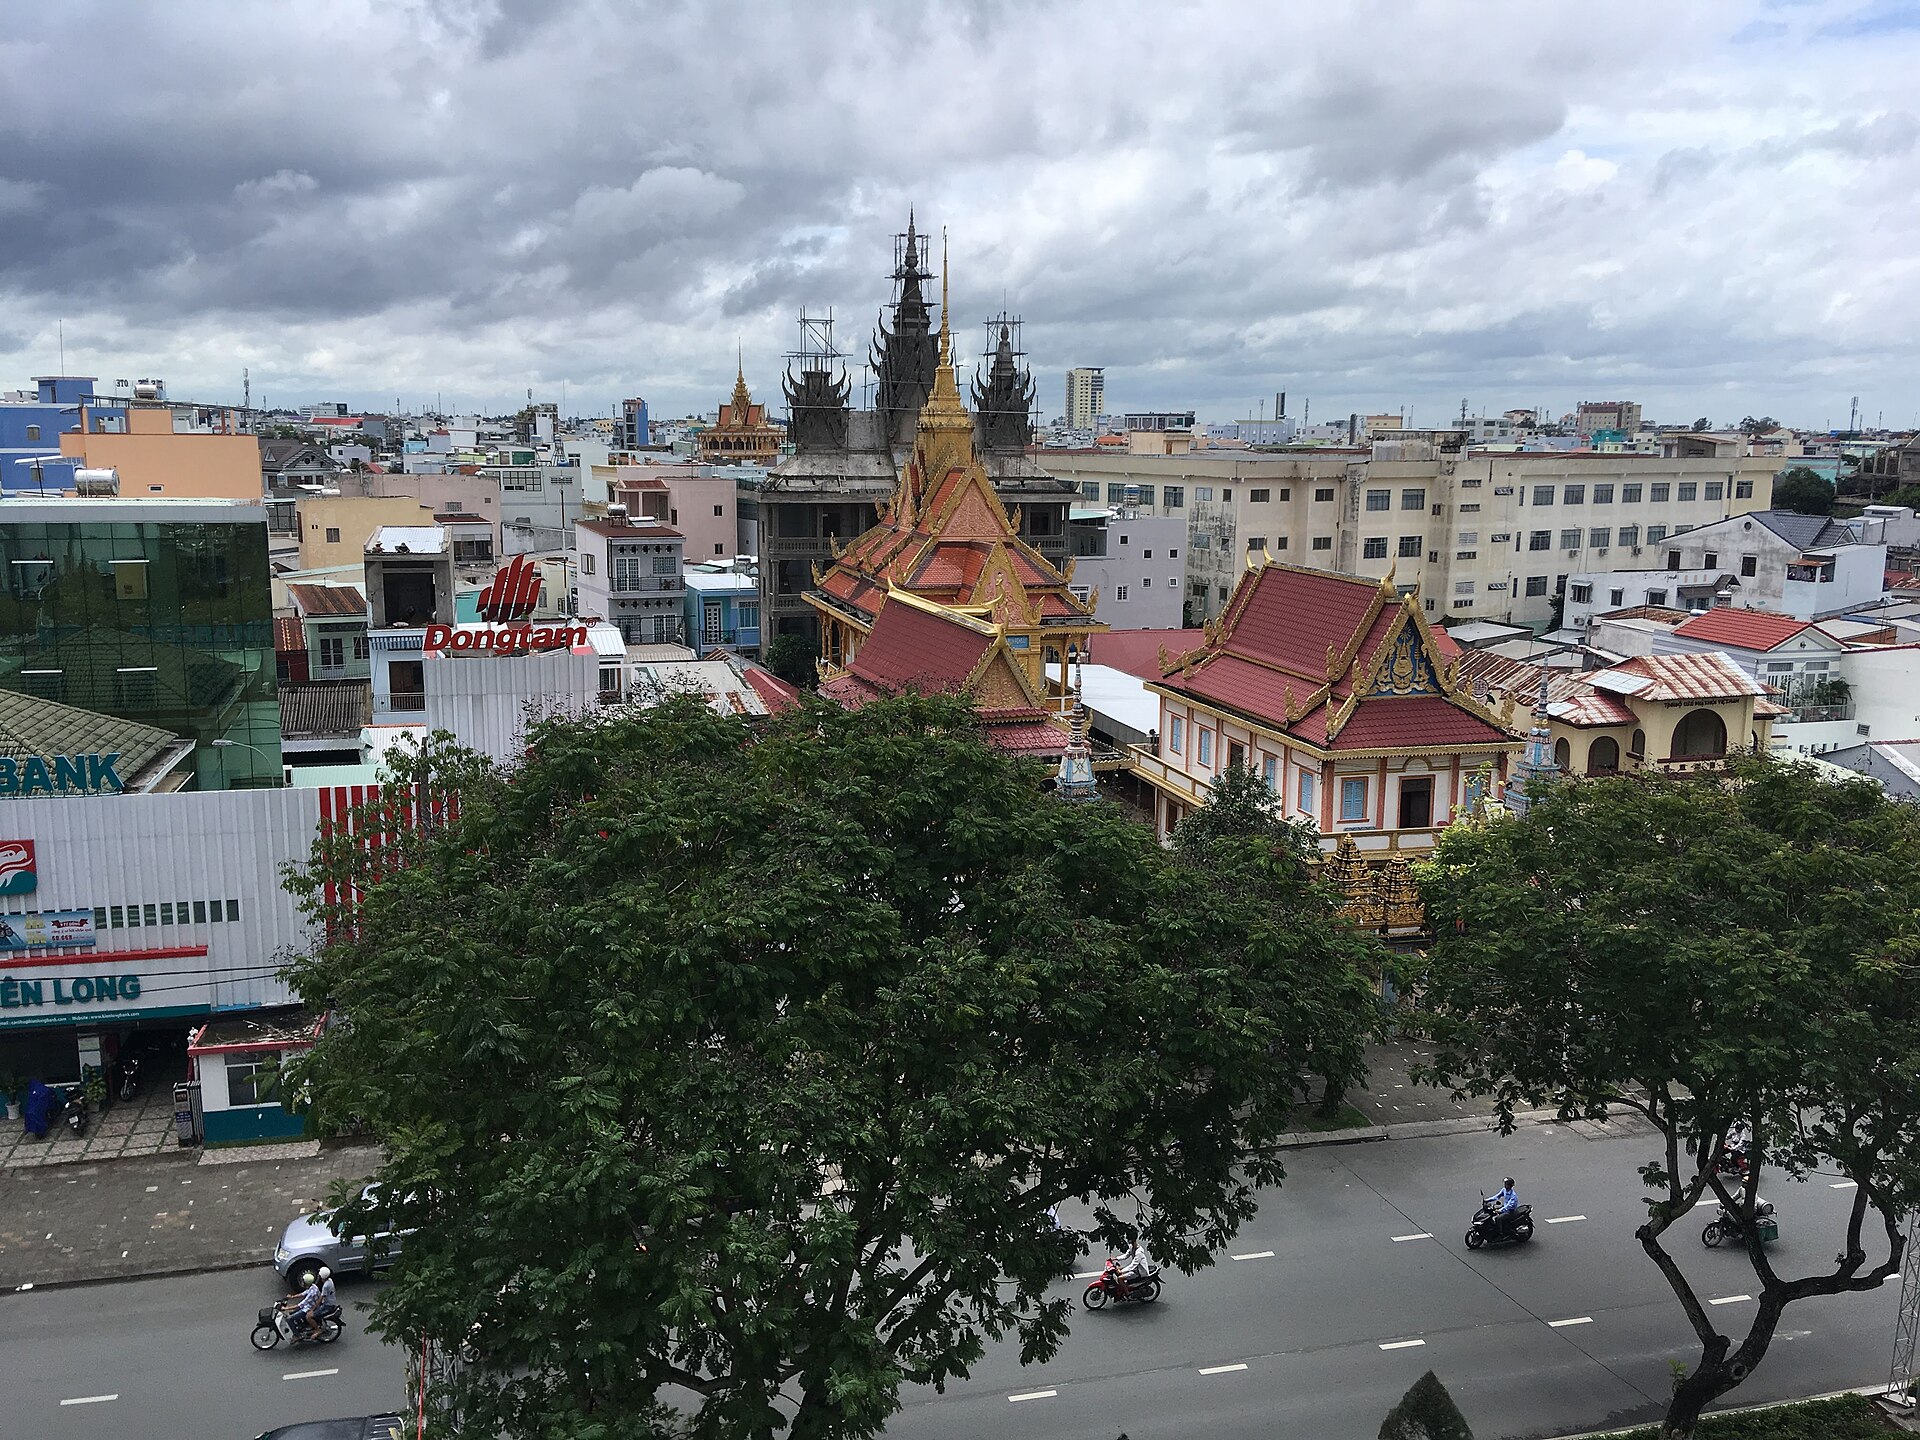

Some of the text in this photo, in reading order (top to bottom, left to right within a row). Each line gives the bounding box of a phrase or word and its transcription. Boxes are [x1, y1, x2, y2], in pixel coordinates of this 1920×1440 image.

[423, 624, 587, 654] Dongtam
[0, 752, 125, 792] BANK
[53, 974, 141, 1006] LONG
